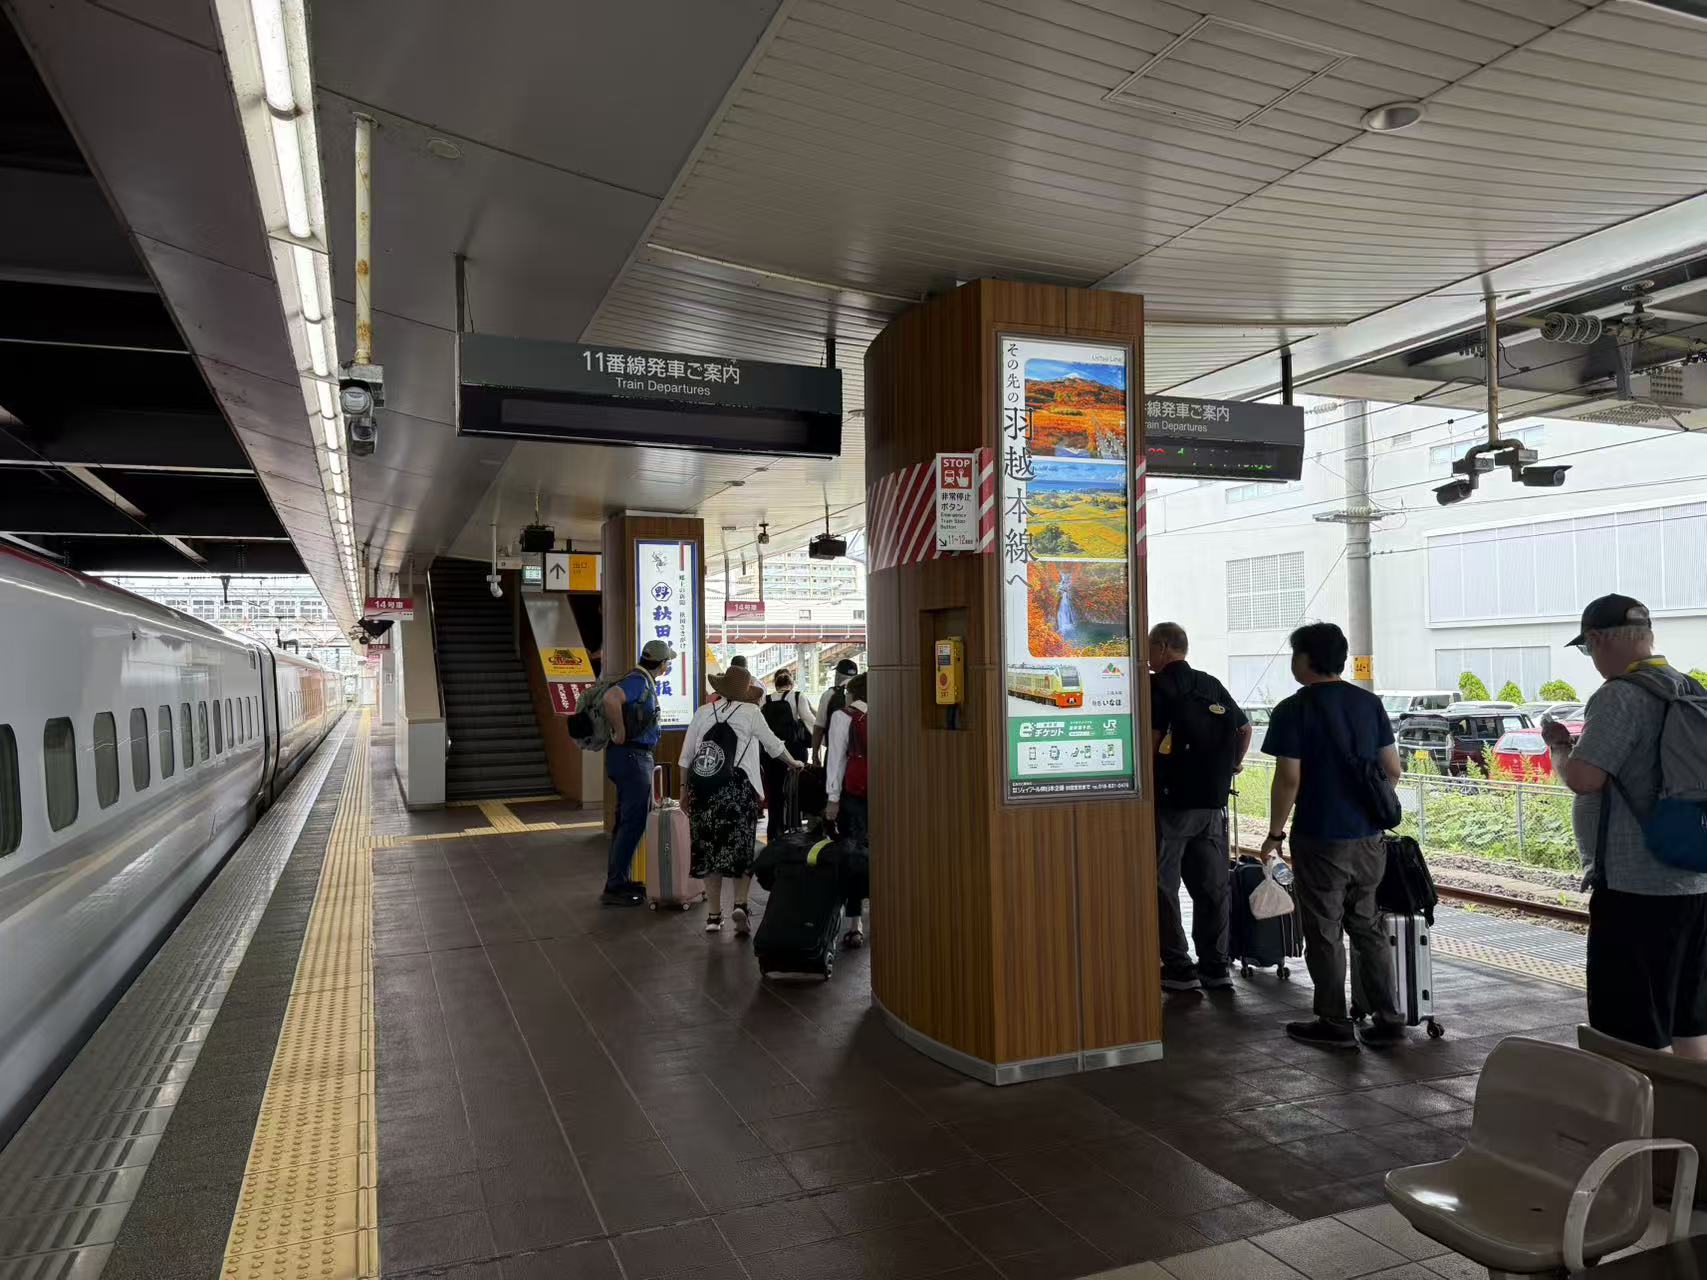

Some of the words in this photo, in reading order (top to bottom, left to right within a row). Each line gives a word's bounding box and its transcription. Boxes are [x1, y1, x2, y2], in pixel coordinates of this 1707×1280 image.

[582, 351, 740, 384] 11番線発車ご案内
[616, 377, 644, 391] Train
[647, 379, 711, 397] Departures
[1145, 400, 1230, 422] 線発車ご案内
[1161, 420, 1208, 433] Departures
[943, 459, 970, 468] STOP
[1003, 343, 1039, 588] その先の羽越本線へ
[941, 492, 971, 502] 非常停止
[940, 503, 964, 512] ボタン
[1102, 719, 1117, 729] JR
